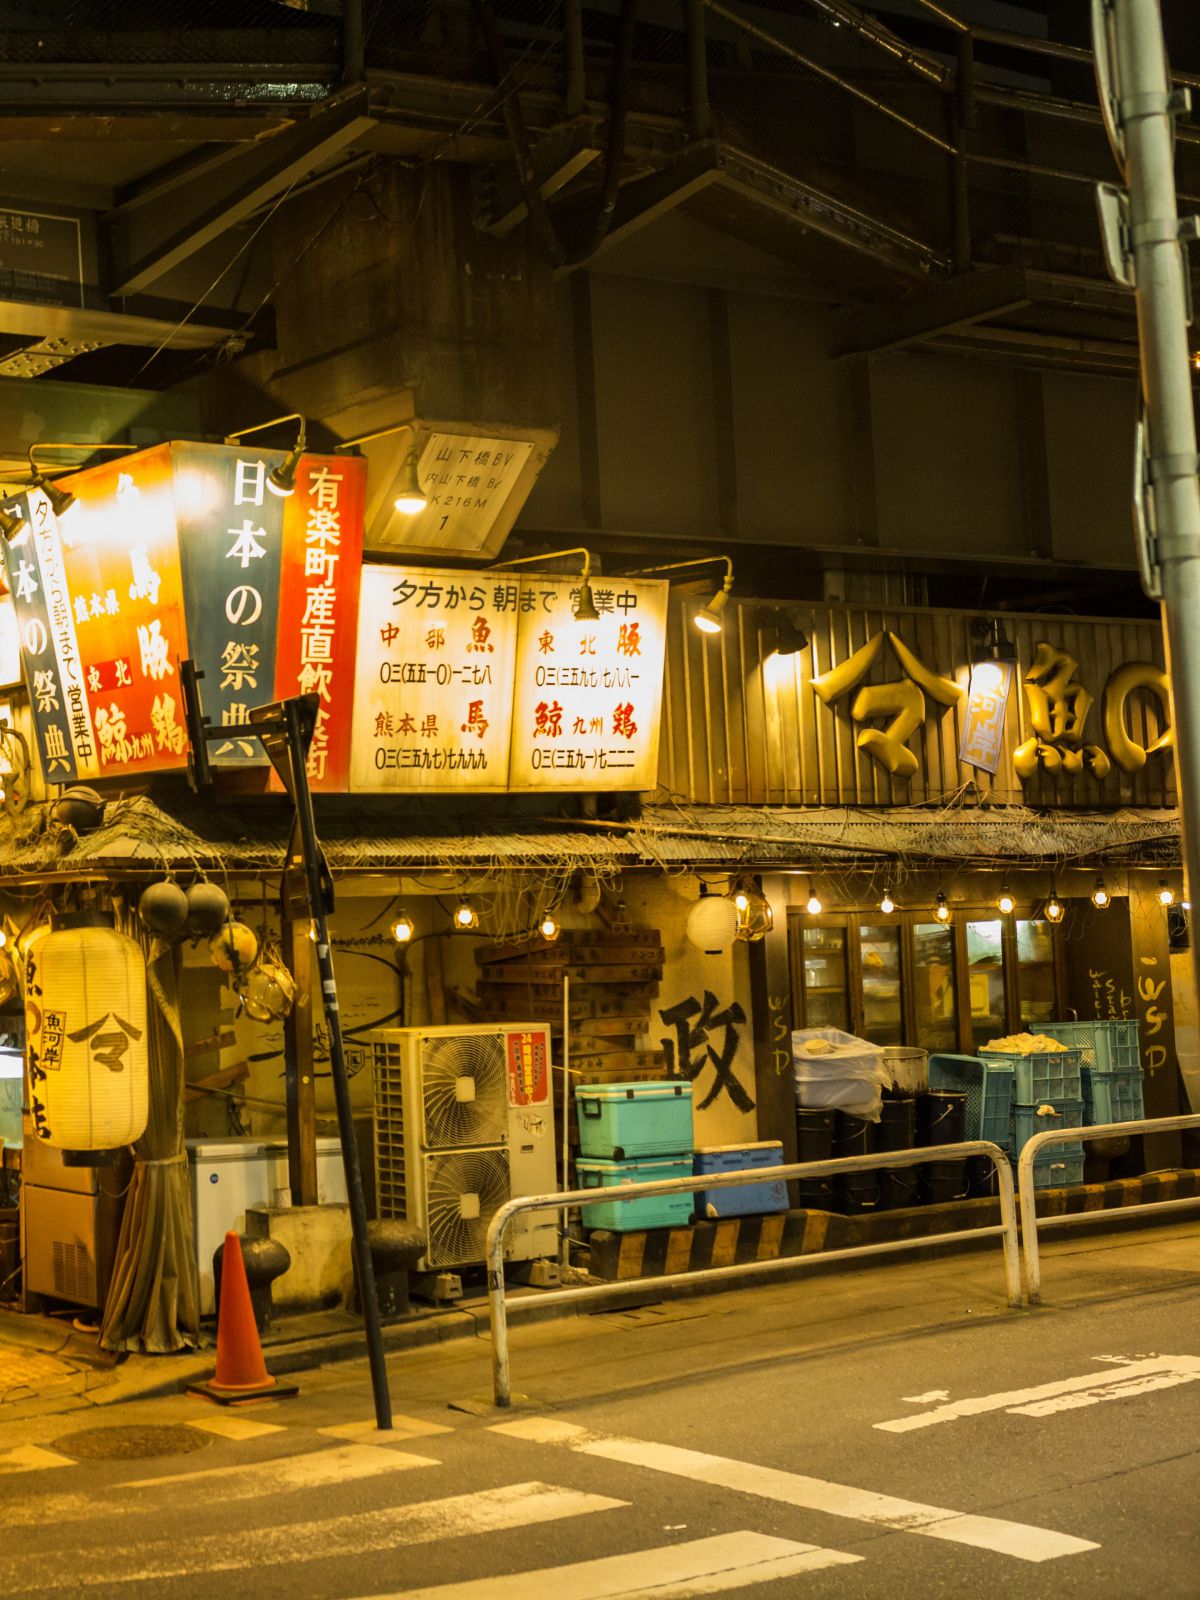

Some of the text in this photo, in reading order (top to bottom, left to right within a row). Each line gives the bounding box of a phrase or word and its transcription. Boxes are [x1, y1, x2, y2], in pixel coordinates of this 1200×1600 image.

[379, 616, 494, 653] 中部 魚
[538, 629, 596, 656] 東北
[86, 660, 132, 694] 東北
[373, 700, 490, 739] 熊本県 馬
[533, 700, 563, 739] 鯨
[573, 716, 603, 736] 九州
[965, 664, 1007, 766] 河岸
[42, 1013, 64, 1066] 魚河岸
